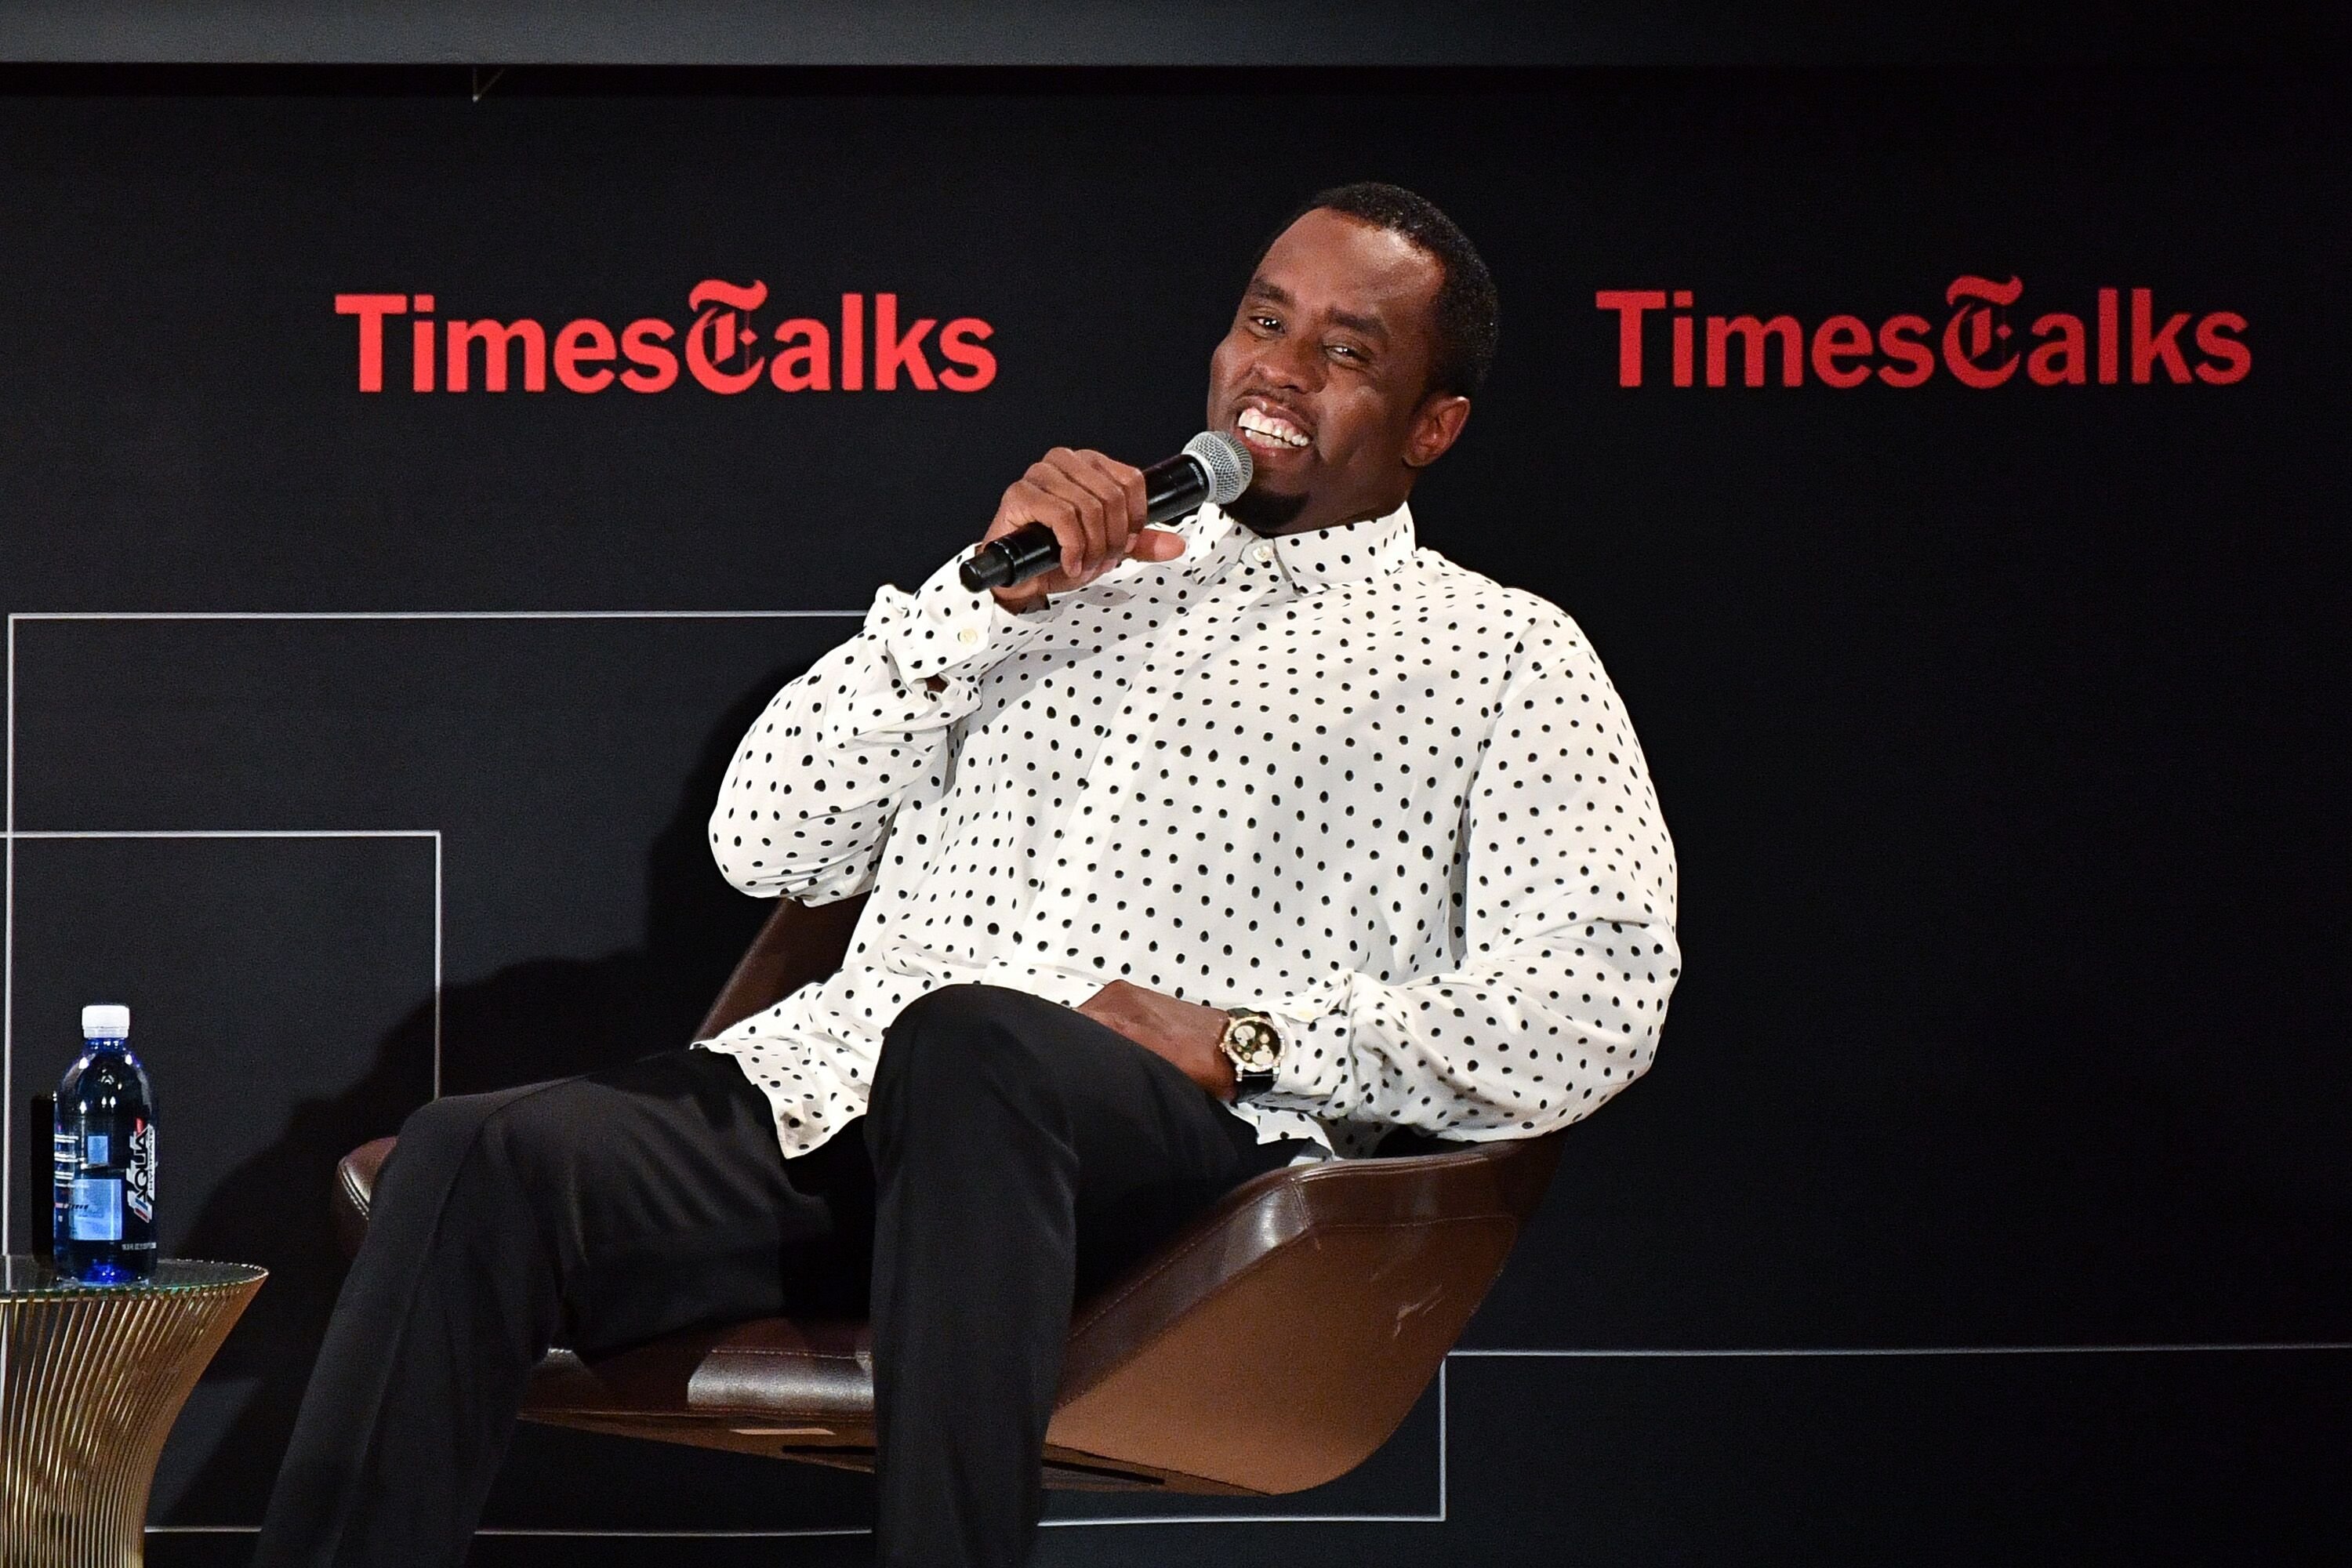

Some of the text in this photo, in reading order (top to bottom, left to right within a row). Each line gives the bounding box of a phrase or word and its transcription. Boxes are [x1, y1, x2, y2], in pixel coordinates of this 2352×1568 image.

[333, 279, 997, 395] TimesTalks
[1595, 276, 2251, 389] TimesTalks
[134, 1127, 149, 1211] AQUA
